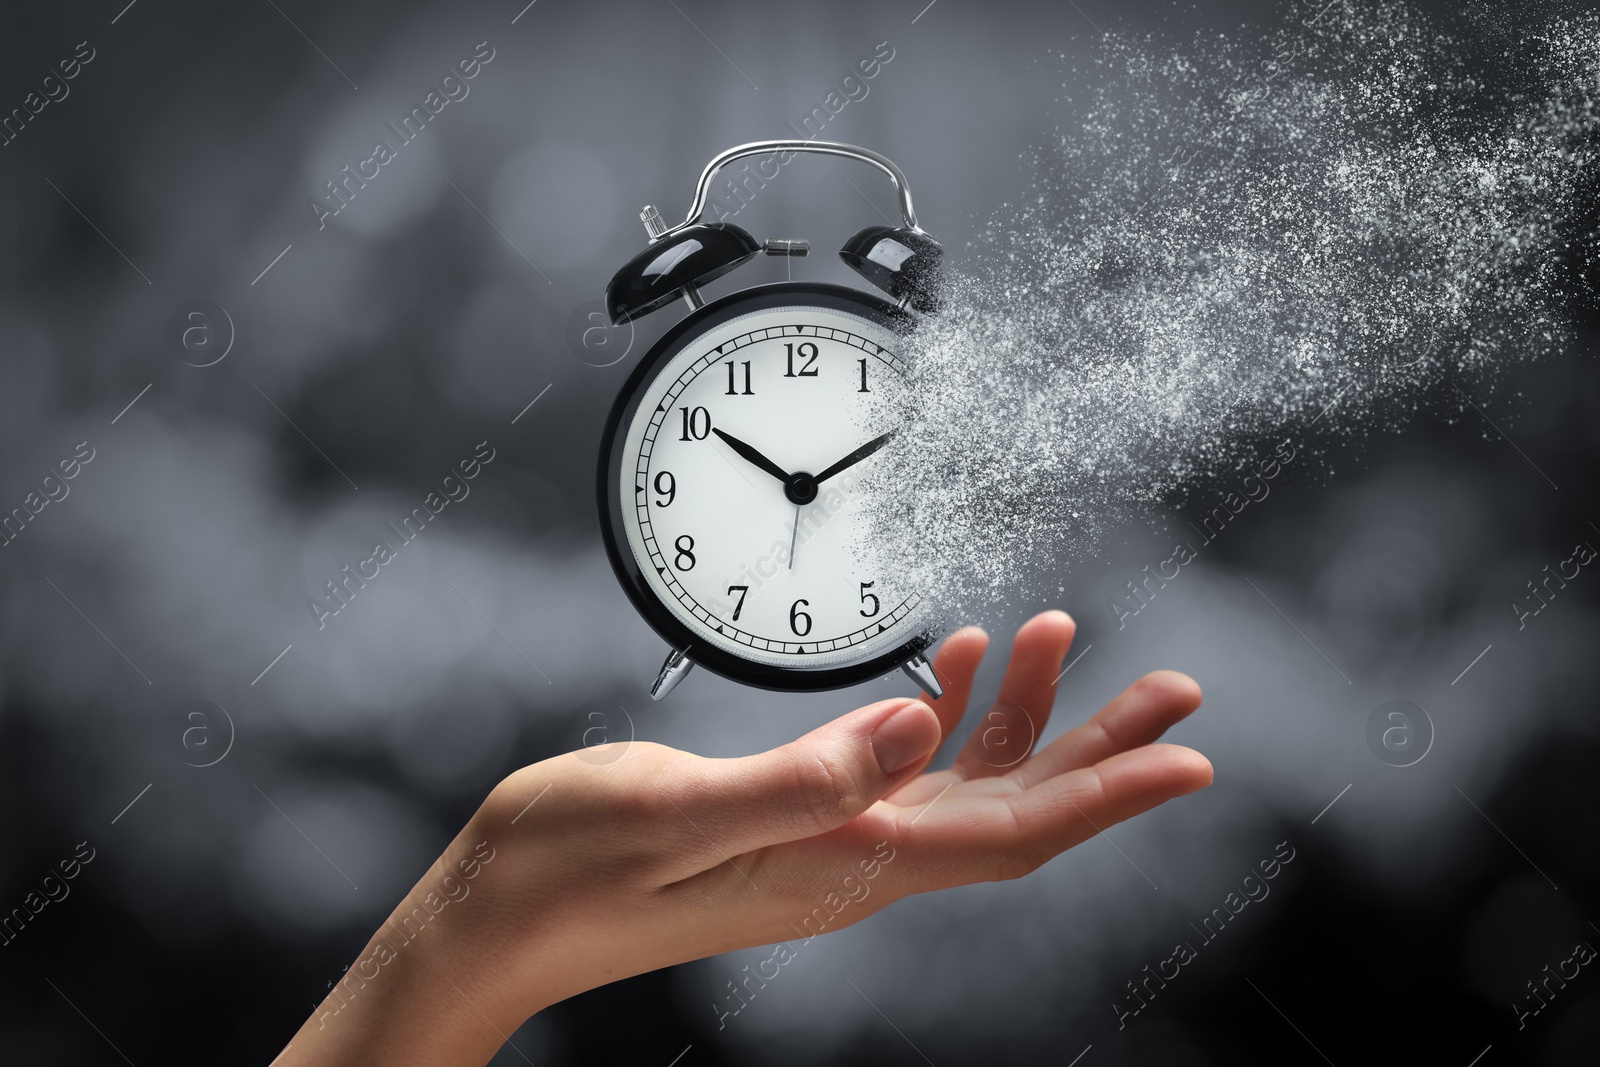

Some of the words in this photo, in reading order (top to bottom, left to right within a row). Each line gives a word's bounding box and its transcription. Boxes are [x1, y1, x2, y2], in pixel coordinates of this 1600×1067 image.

[724, 360, 755, 395] 11
[783, 342, 819, 377] 12
[857, 358, 871, 393] 1
[678, 406, 712, 442] 10
[653, 470, 676, 508] 9
[674, 534, 696, 572] 8
[727, 585, 749, 622] 7
[789, 598, 813, 637] 6
[859, 580, 880, 618] 5
